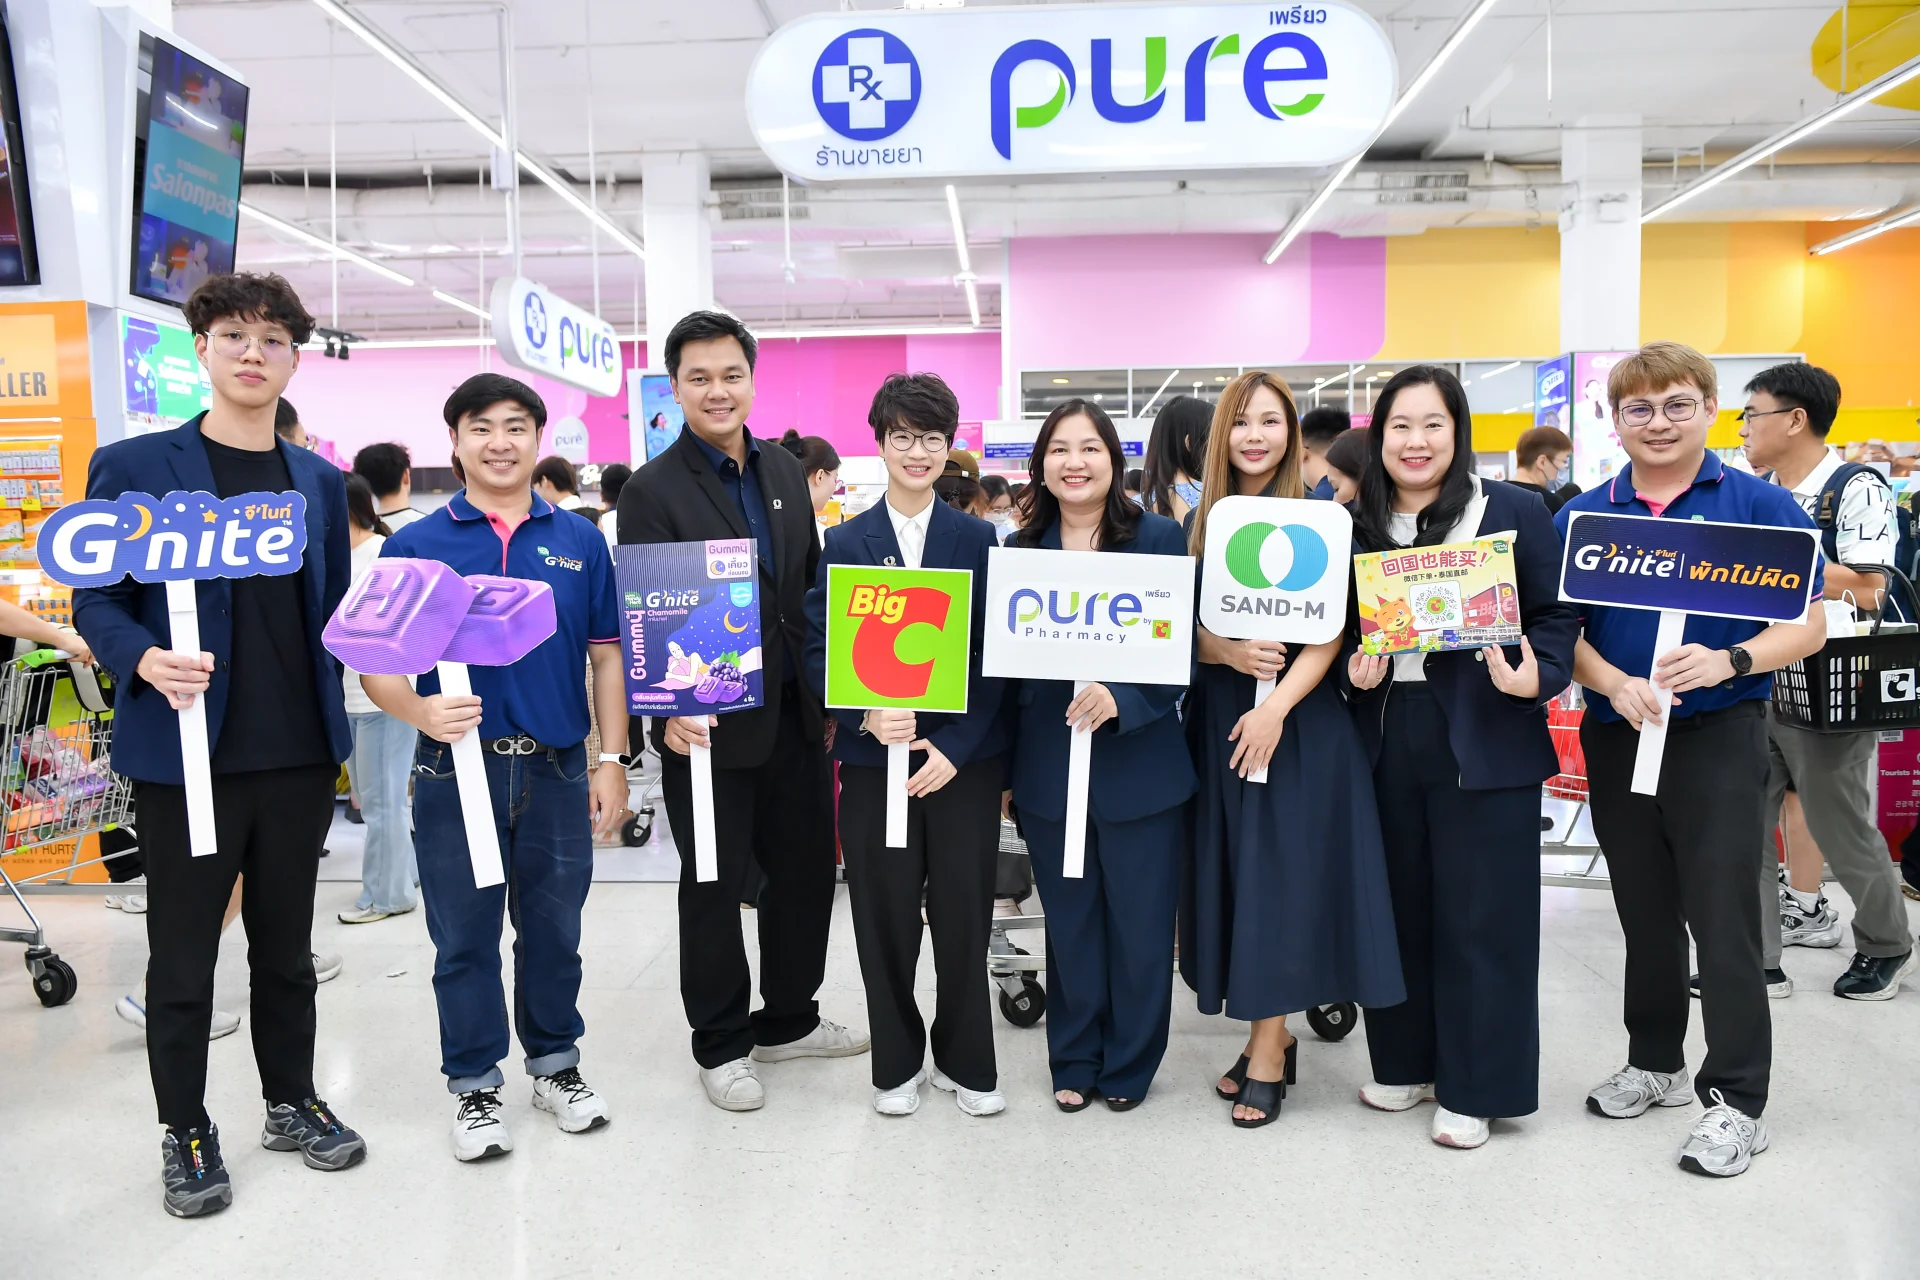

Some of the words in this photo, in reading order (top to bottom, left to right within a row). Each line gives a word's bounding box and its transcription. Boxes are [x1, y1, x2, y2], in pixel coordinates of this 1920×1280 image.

[1269, 5, 1328, 26] เพรียว
[848, 64, 884, 101] Rx
[990, 31, 1329, 161] pure
[815, 144, 923, 167] ร้านขายยา
[150, 162, 236, 218] Salonpas
[559, 316, 614, 374] pure
[555, 433, 583, 447] pure
[1689, 560, 1801, 590] พักไม่ผิด
[849, 585, 908, 624] Big
[1145, 589, 1171, 598] เพรียว
[1220, 594, 1326, 620] SAND-M
[647, 608, 689, 617] Chamomile
[1008, 588, 1142, 635] pure
[1143, 617, 1152, 626] by
[629, 610, 648, 681] Gummy
[852, 587, 952, 699] C
[1025, 627, 1127, 644] Pharmacy
[1885, 673, 1900, 683] Big
[1887, 672, 1910, 699] C
